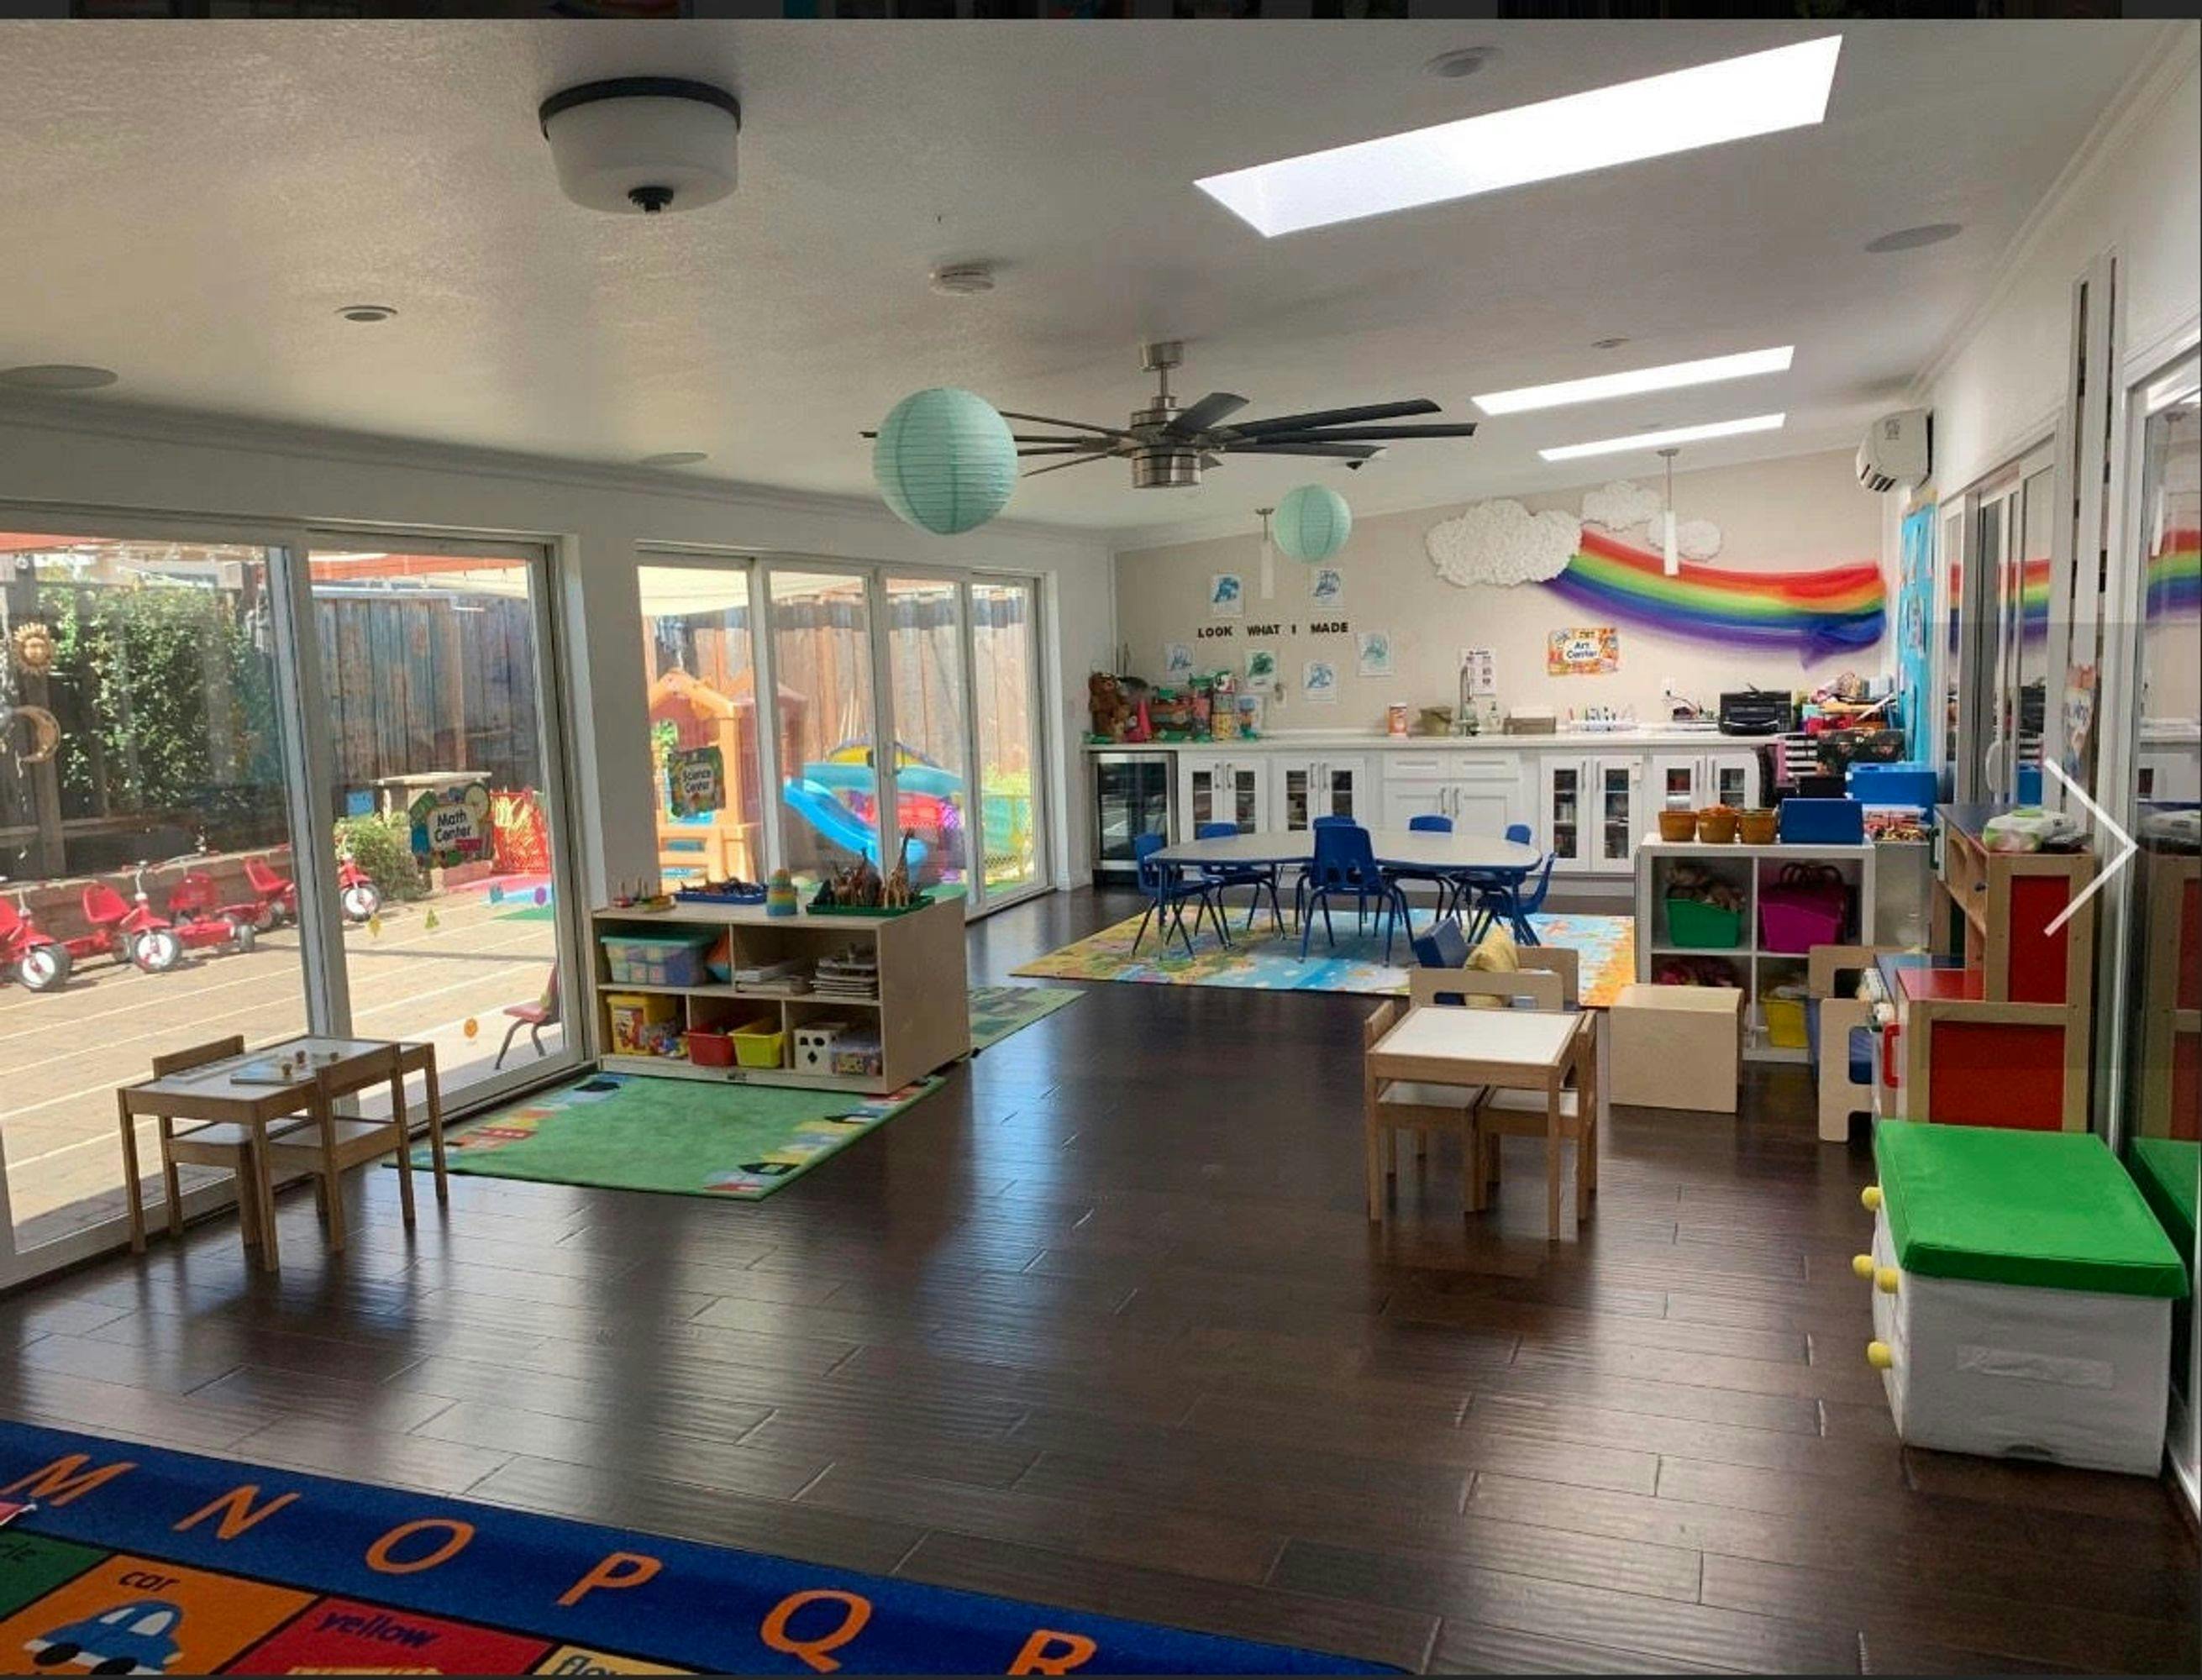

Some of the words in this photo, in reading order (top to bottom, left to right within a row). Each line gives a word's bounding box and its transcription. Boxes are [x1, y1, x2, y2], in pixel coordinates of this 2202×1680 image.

[1197, 626, 1232, 638] LOOK
[1247, 624, 1280, 636] WHAT
[1311, 622, 1348, 633] MADE
[1574, 641, 1590, 649] Art
[1567, 650, 1598, 659] Center
[682, 769, 712, 782] Science
[438, 809, 466, 827] Math
[434, 826, 471, 843] Center
[0, 1453, 139, 1507] M
[172, 1484, 301, 1541] N
[365, 1518, 476, 1575] O
[557, 1551, 663, 1608] P
[760, 1589, 873, 1673] Q
[1007, 1629, 1098, 1676] R
[118, 1570, 180, 1593] car
[314, 1610, 441, 1648] yellow
